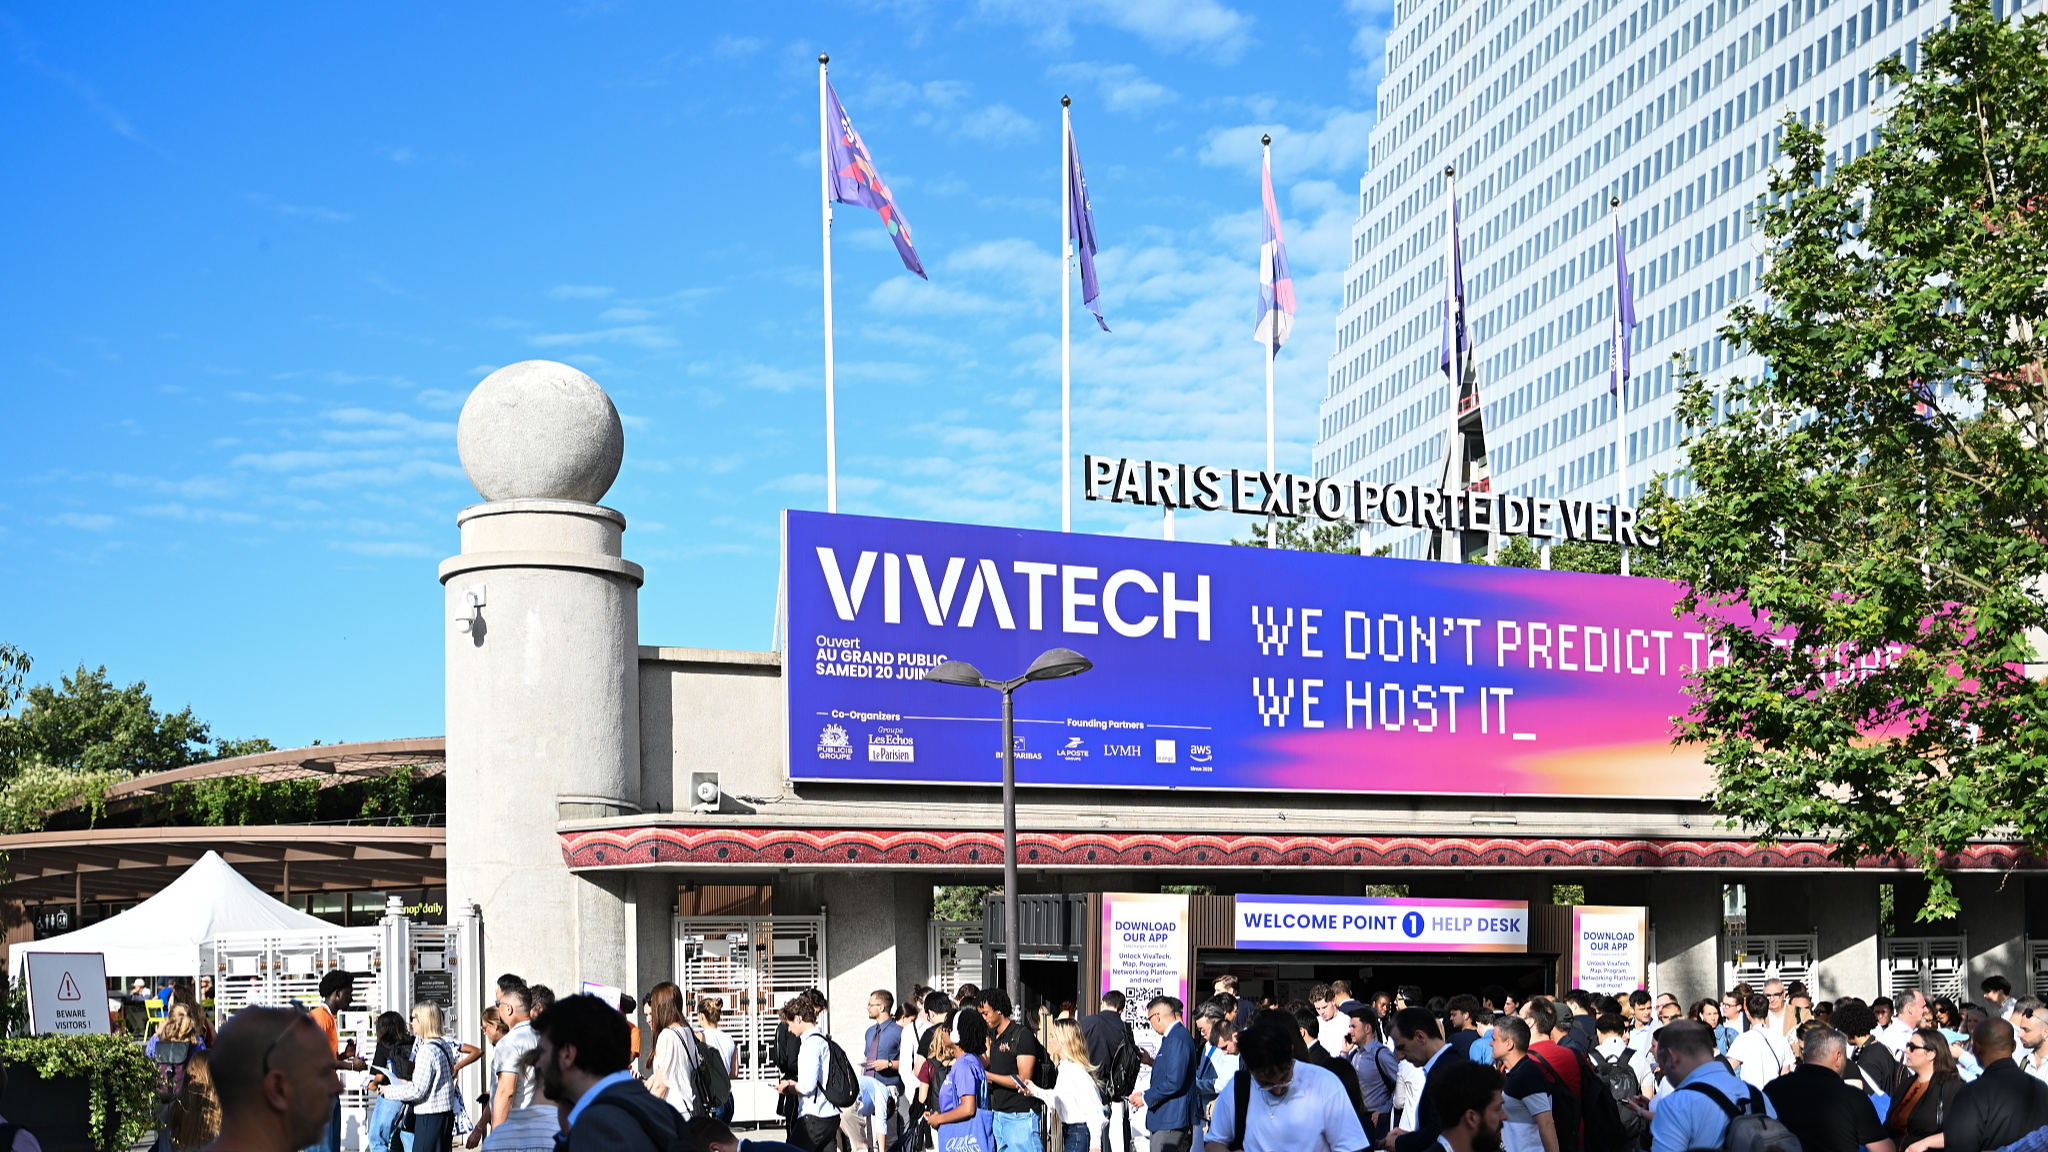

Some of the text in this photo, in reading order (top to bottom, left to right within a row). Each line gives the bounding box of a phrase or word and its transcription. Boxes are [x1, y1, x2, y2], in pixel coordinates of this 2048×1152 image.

[1085, 454, 1225, 511] PARIS
[1231, 468, 1347, 522] EXPO
[1353, 479, 1489, 532] PORTE
[1498, 493, 1559, 539] DE
[815, 546, 1211, 641] VIVATECH
[815, 634, 861, 649] Ouvert
[1252, 605, 1323, 658] WE
[1344, 610, 1481, 666] DON'T
[1497, 619, 1673, 676] PREDICT
[815, 648, 837, 661] AU
[840, 649, 894, 665] GRAND
[815, 662, 872, 679] SAMEDI
[875, 665, 893, 679] 20
[1253, 676, 1325, 728] WE
[1346, 680, 1465, 733] HOST
[831, 709, 901, 722] Co-Organizers
[1067, 718, 1144, 730] Founding Partners
[817, 746, 853, 754] PUBLICIS
[1056, 749, 1089, 757] LA POSTE
[1103, 744, 1142, 757] LVMH
[1190, 744, 1212, 755] aws
[1115, 921, 1176, 931] DOWNLOAD
[1244, 913, 1338, 930] WELCOME
[1342, 915, 1397, 931] POINT
[1431, 916, 1473, 932] HELP
[1477, 917, 1521, 933] DESK
[1123, 932, 1168, 942] OUR APP
[1583, 931, 1635, 941] DOWNLOAD
[1590, 942, 1628, 951] OUR APP
[1142, 952, 1172, 960] VivaTech,
[1112, 968, 1150, 977] Networking
[1581, 974, 1613, 982] Networking
[56, 1009, 87, 1019] BEWARE
[55, 1021, 87, 1030] VISITORS
